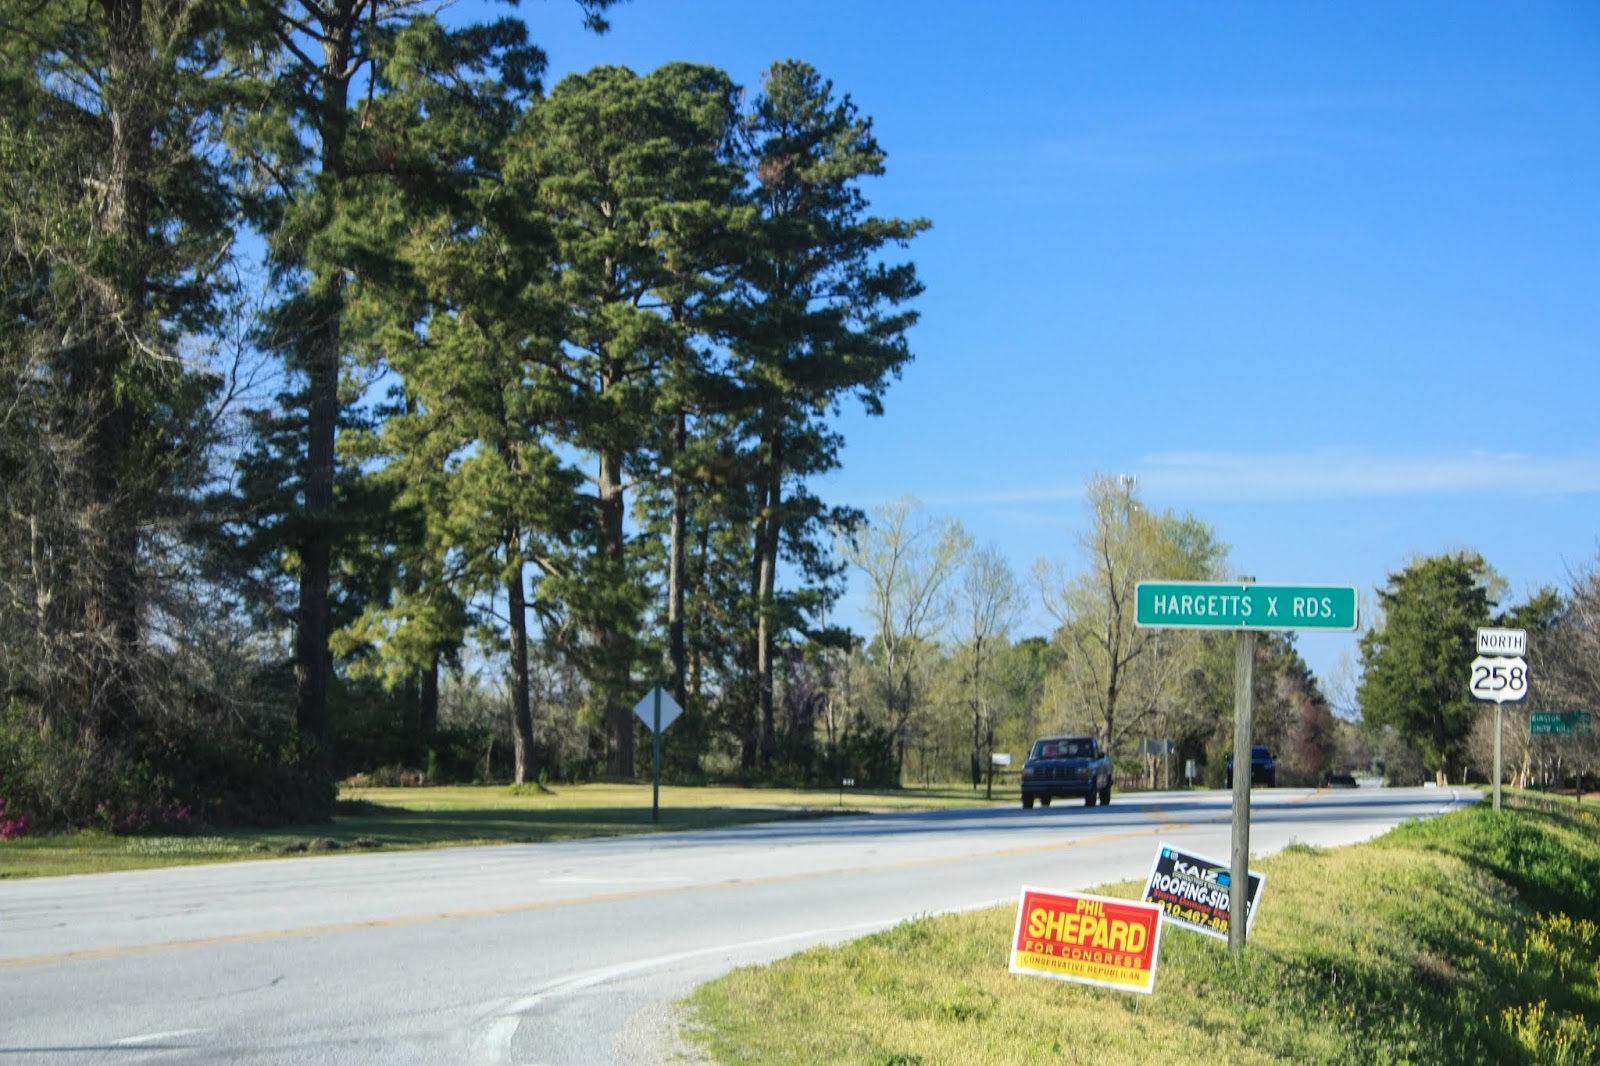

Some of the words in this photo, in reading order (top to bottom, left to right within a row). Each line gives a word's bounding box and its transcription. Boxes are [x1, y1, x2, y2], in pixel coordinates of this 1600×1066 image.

[1154, 594, 1252, 617] HARGETTS
[1267, 597, 1278, 617] X
[1293, 597, 1336, 618] RDS.
[1480, 634, 1522, 649] NORTH
[1474, 666, 1524, 691] 258
[1076, 899, 1106, 918] PHIL
[1153, 889, 1178, 903] Storm
[1179, 896, 1211, 914] Damage
[1028, 907, 1146, 953] SHEPARD
[1025, 940, 1054, 955] FOR
[1061, 946, 1142, 969] CONGRESS
[1023, 955, 1084, 971] CONSERVATIVE
[1087, 963, 1140, 981] REPUBLICAN
